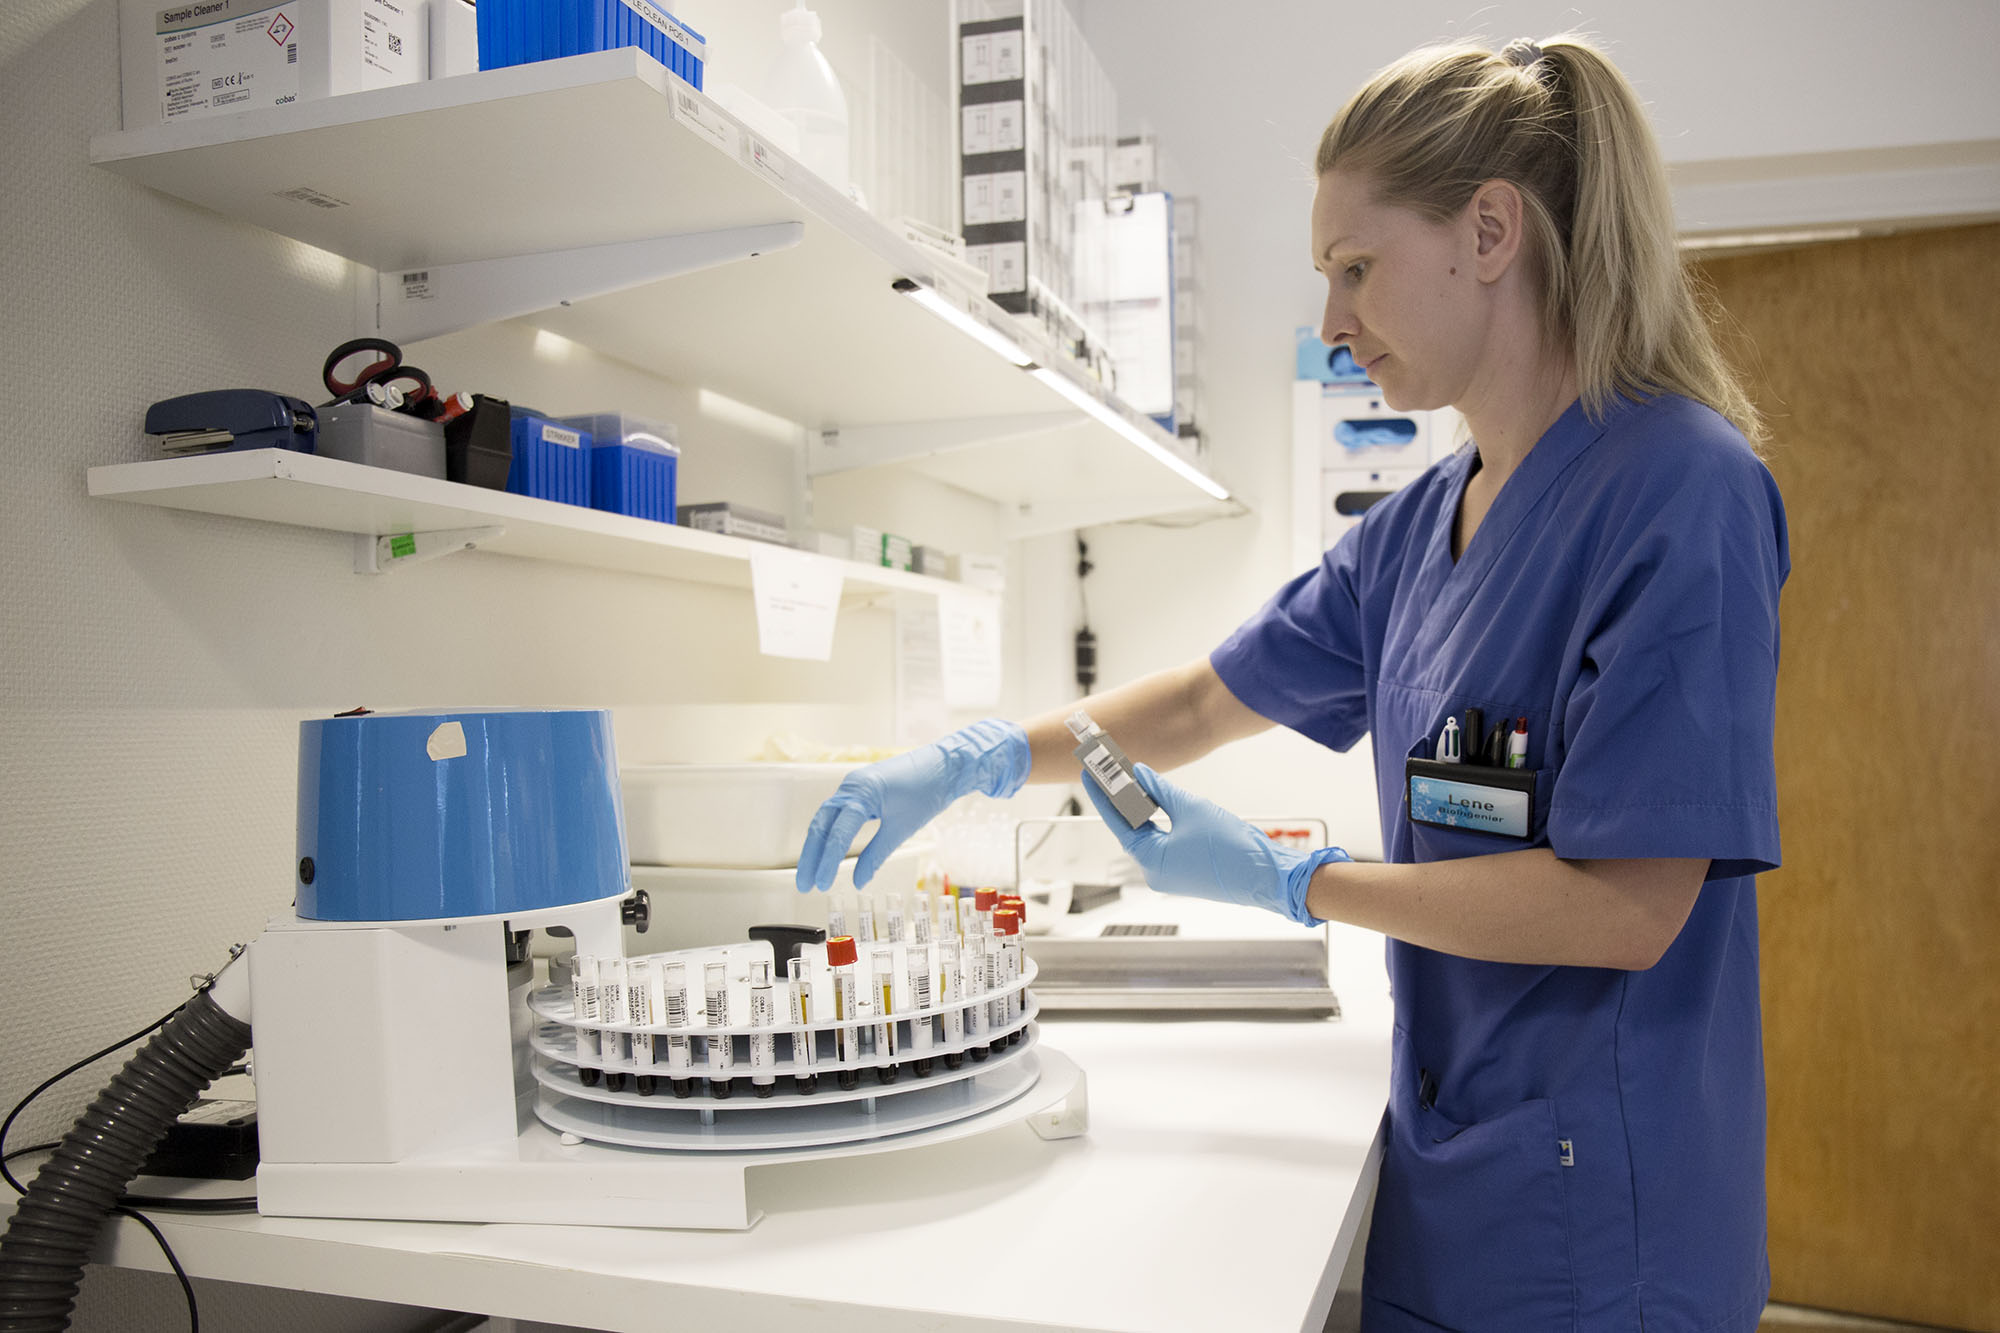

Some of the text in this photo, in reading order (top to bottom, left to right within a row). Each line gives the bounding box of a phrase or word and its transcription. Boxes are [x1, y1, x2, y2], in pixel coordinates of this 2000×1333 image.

[164, 0, 229, 24] Sample Cleaner 1
[643, 6, 668, 30] CLEAN
[276, 94, 296, 105] cobas
[1448, 794, 1494, 812] Lene
